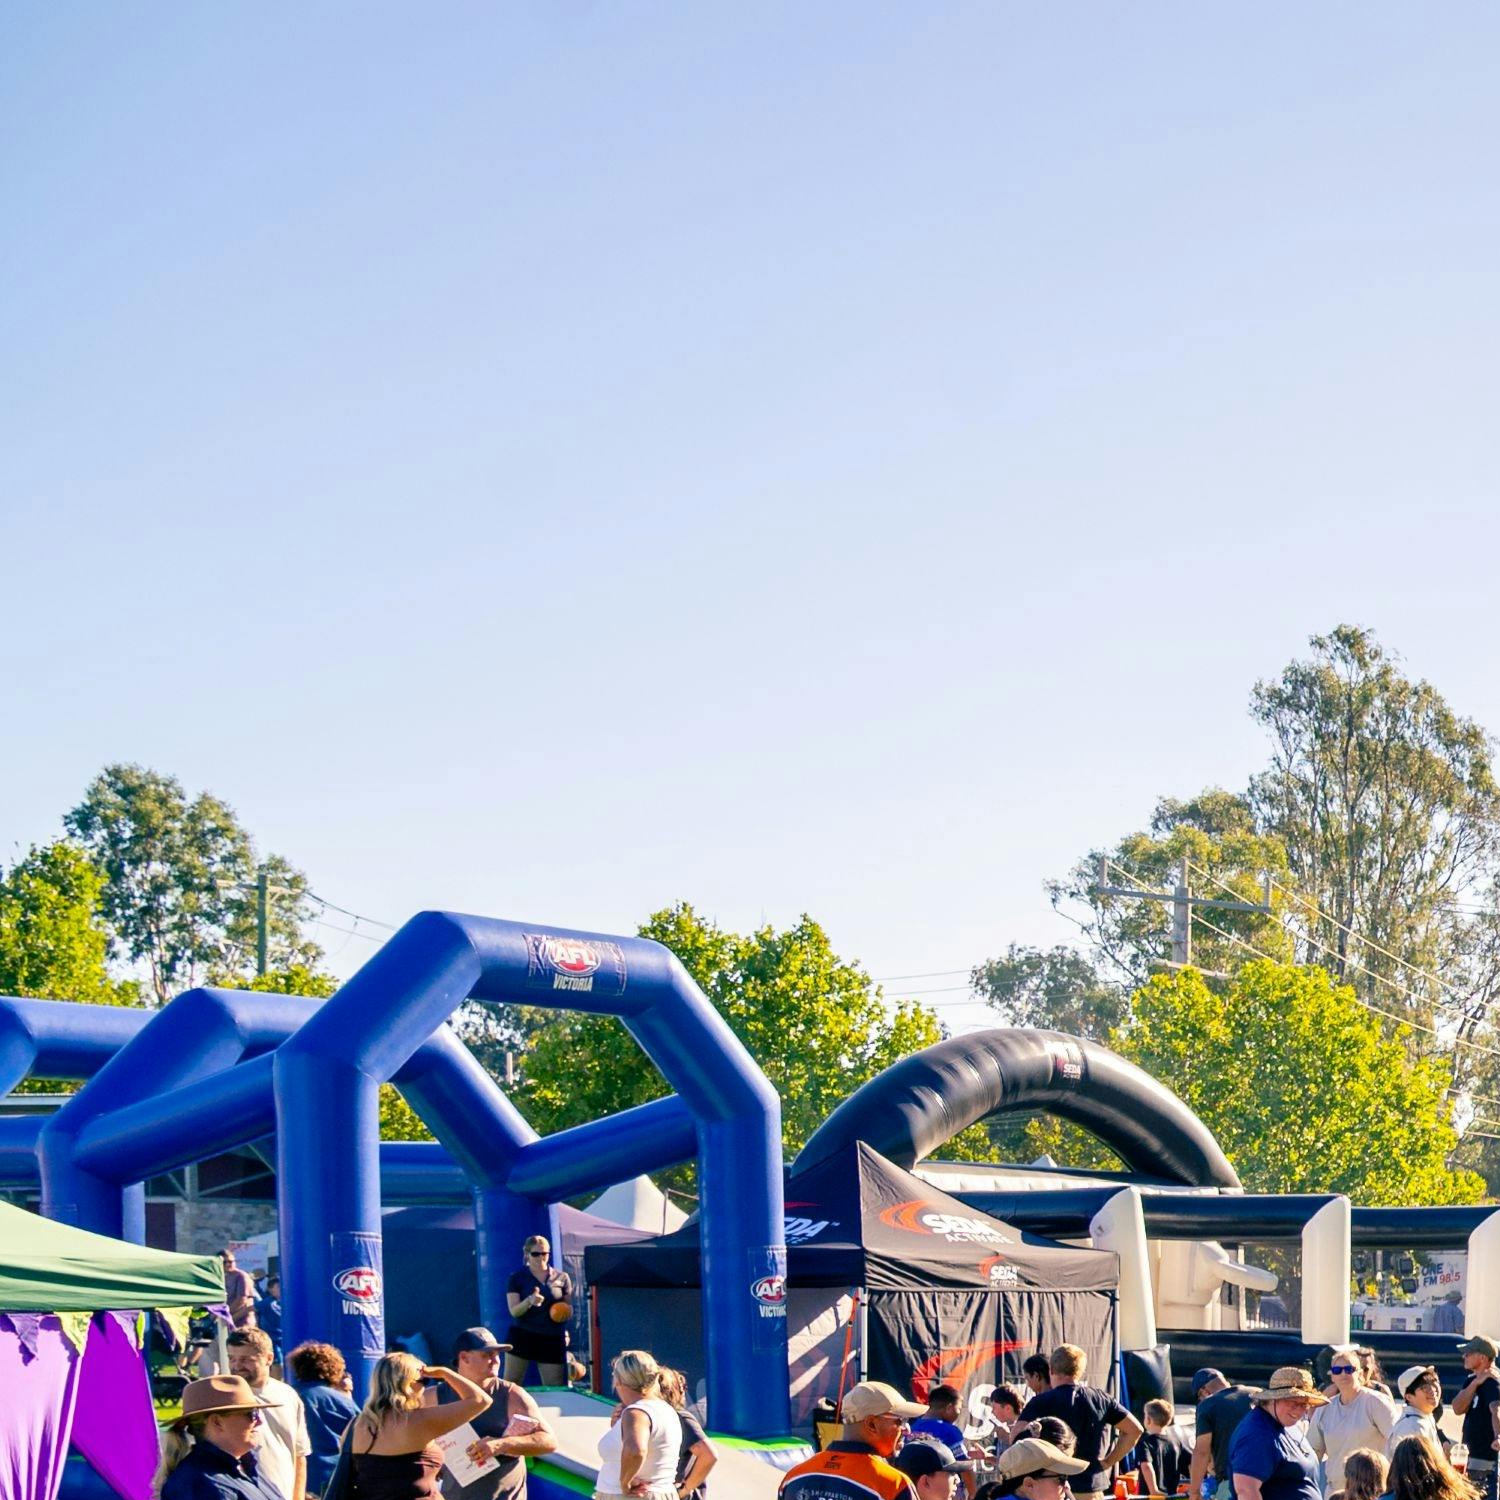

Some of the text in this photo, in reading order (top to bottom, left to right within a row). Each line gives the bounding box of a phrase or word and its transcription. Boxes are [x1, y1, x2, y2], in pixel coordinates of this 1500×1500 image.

[553, 942, 598, 967] AFL
[552, 972, 594, 993] VICTORIA
[922, 1213, 1001, 1237] SEDA
[990, 1265, 1019, 1280] SEDA
[1421, 1263, 1444, 1276] ONE
[1423, 1272, 1461, 1286] FM 98.5
